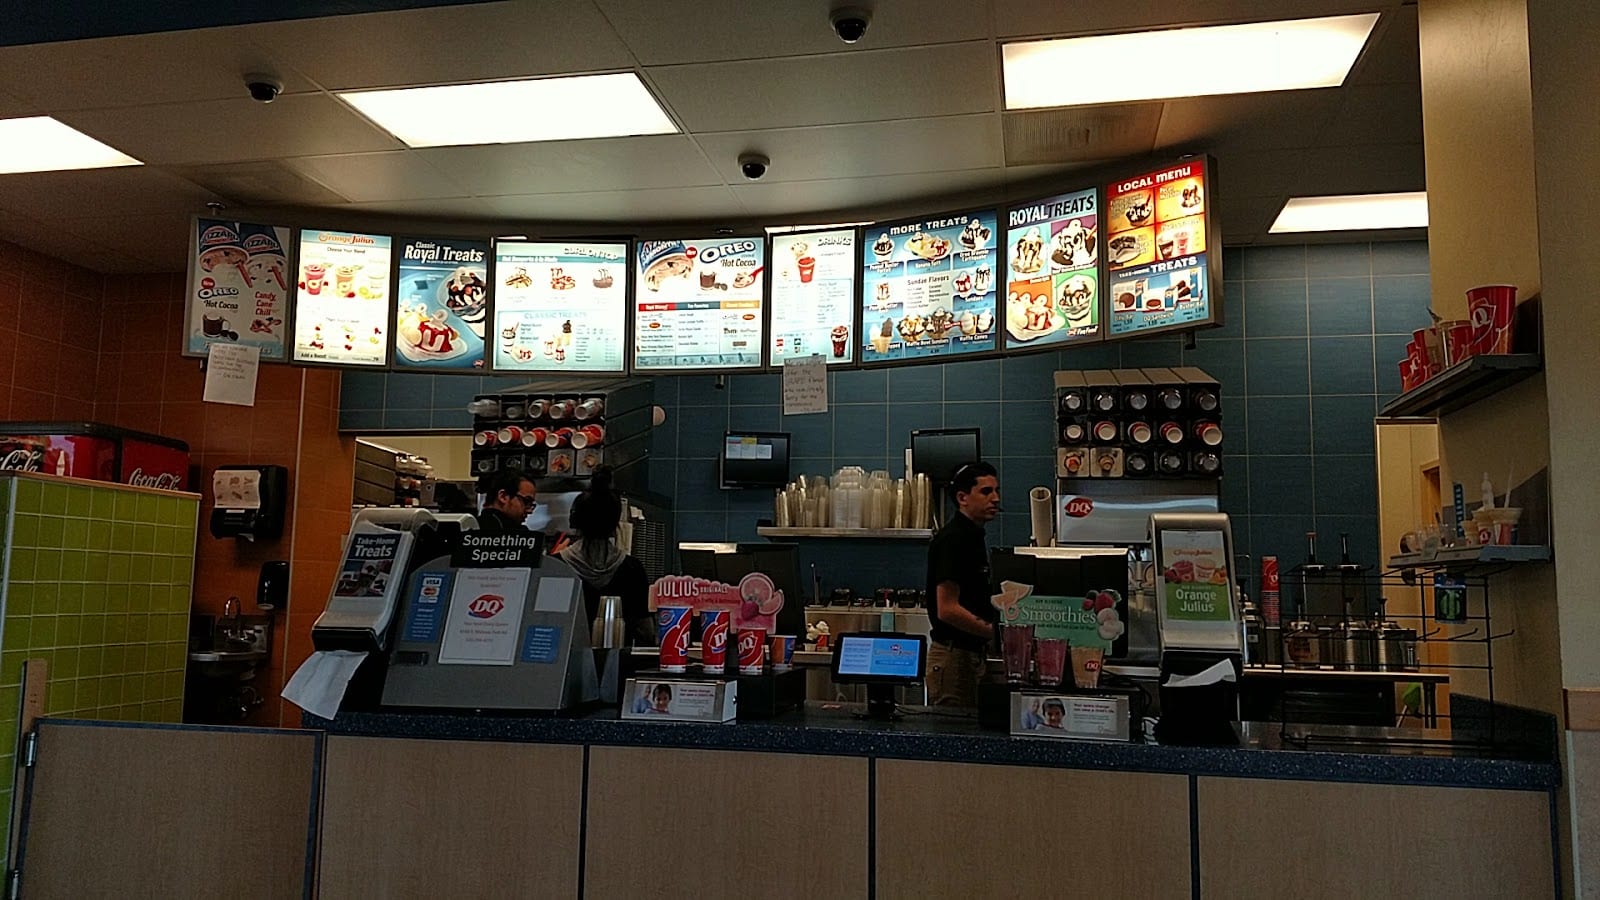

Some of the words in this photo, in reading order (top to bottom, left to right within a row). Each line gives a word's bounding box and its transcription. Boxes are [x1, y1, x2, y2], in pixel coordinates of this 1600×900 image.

[1117, 176, 1153, 193] LOCAL
[1156, 166, 1191, 183] MENU
[1009, 204, 1049, 227] ROYAL
[1047, 195, 1094, 218] TREATS
[890, 224, 922, 235] MORE
[926, 216, 968, 230] TREATS
[415, 241, 436, 249] Classic
[818, 236, 851, 246] DRINKS
[404, 245, 441, 264] Royal
[443, 246, 485, 262] Treats
[700, 240, 756, 264] OREO
[722, 258, 734, 268] Hot
[735, 257, 756, 267] Cocoa
[1150, 256, 1197, 273] TREATS
[928, 275, 949, 283] Flavors
[199, 287, 239, 299] OREO
[255, 291, 276, 301] Candy
[204, 300, 217, 308] Hot
[219, 301, 238, 309] Cocoa
[1070, 502, 1091, 514] DQ
[462, 534, 536, 549] Something
[355, 545, 393, 557] Treats
[472, 549, 521, 563] Special
[657, 581, 700, 597] JULIUS
[1175, 589, 1217, 602] Orange
[473, 599, 500, 614] DQ
[1180, 601, 1215, 612] Julius
[1021, 605, 1097, 624] Smoothies
